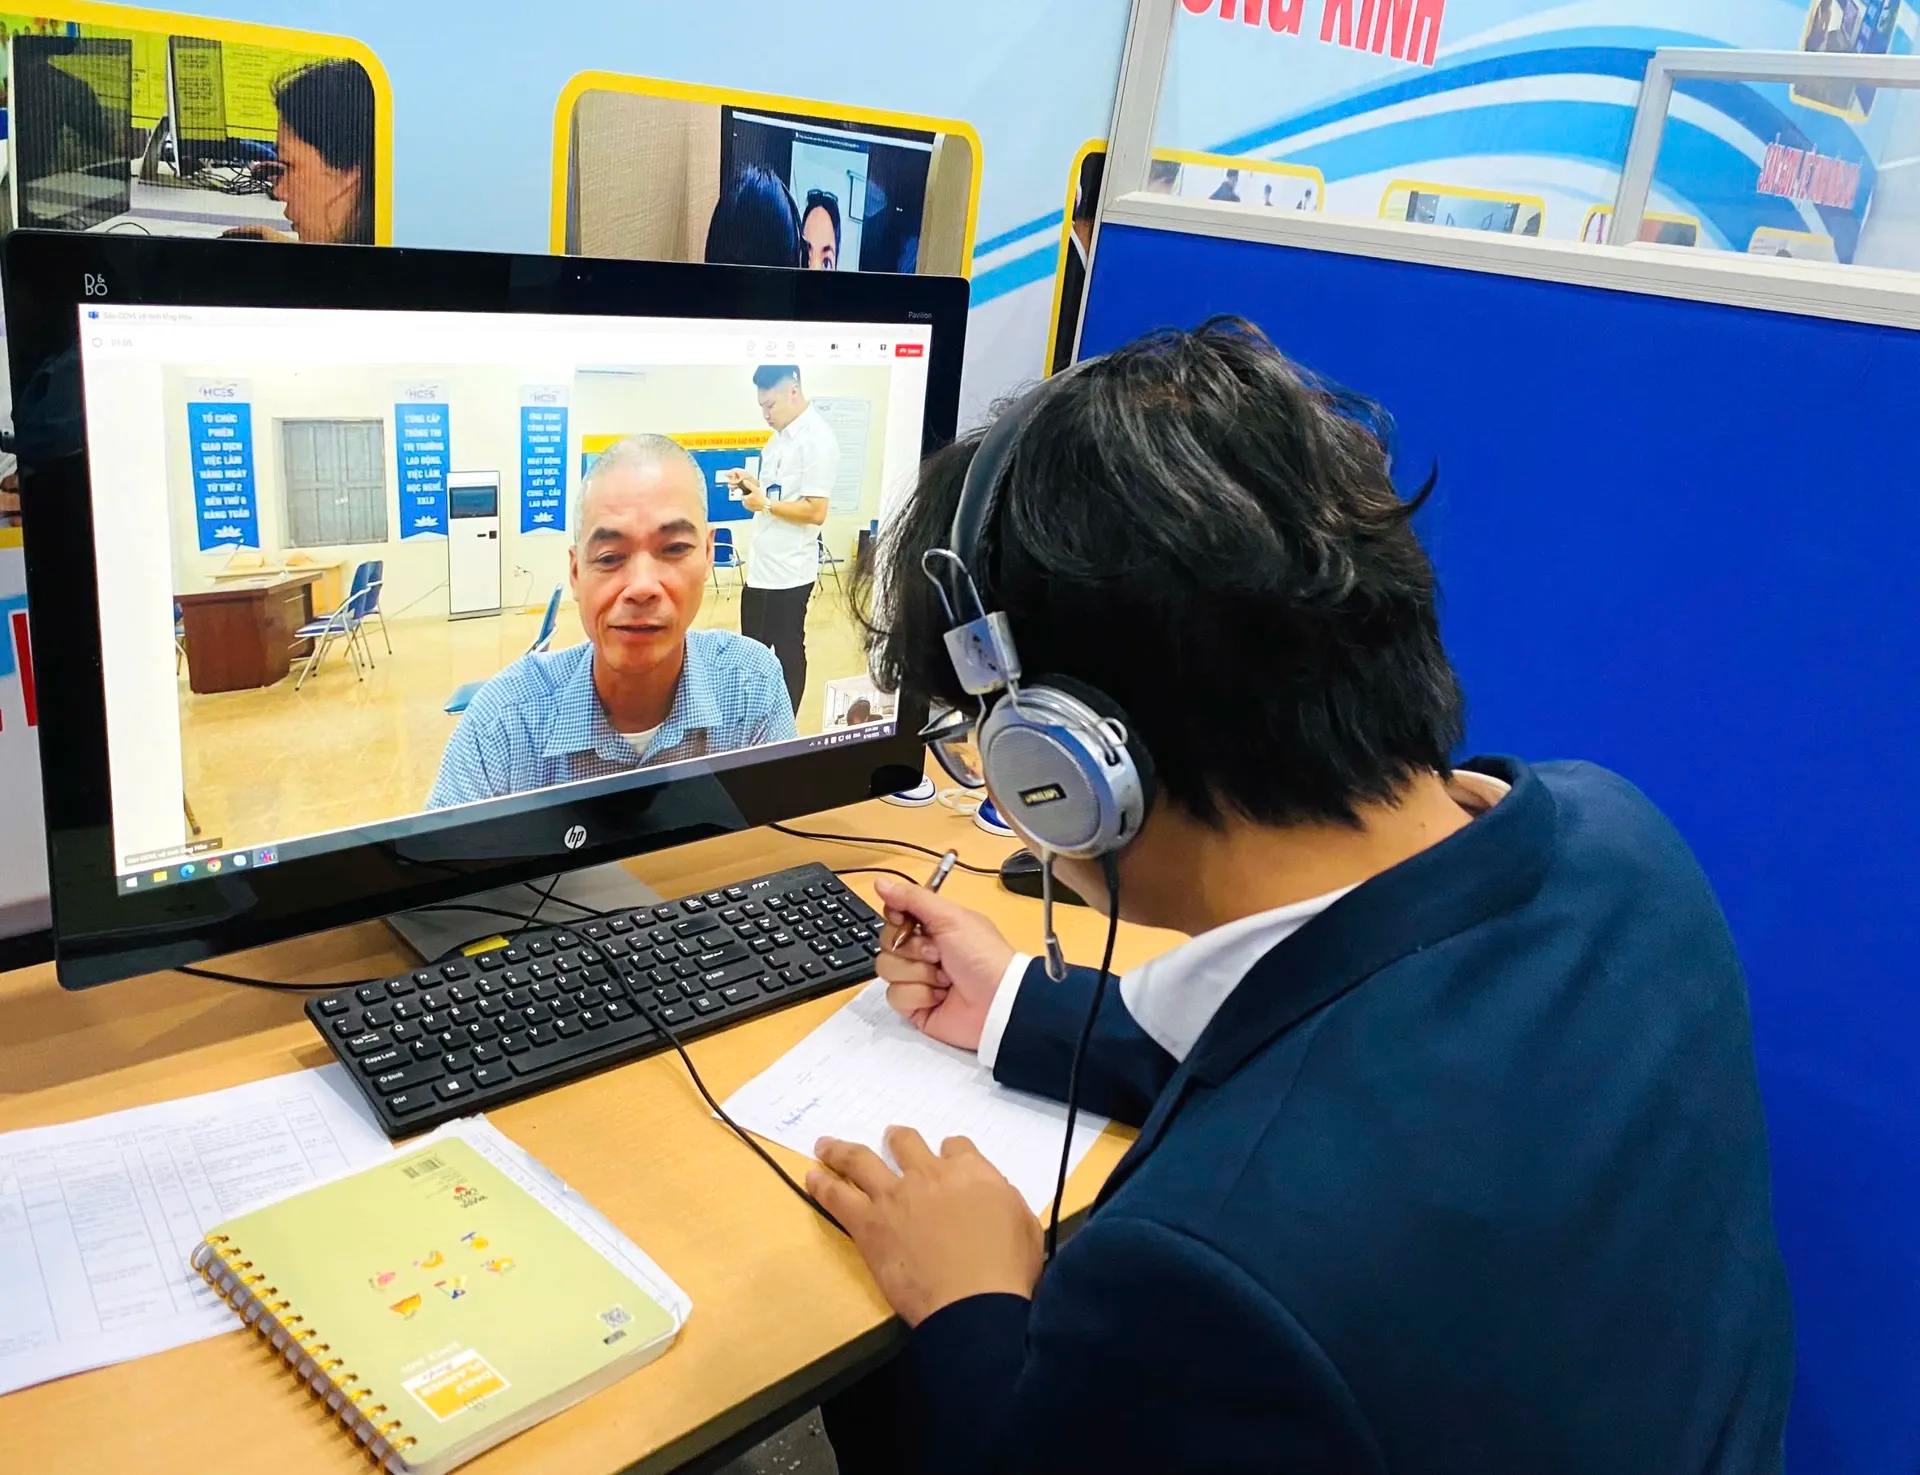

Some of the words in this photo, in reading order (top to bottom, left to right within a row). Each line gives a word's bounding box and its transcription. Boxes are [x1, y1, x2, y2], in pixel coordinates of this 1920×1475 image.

[908, 311, 932, 319] Pavilion
[565, 825, 587, 849] hp
[752, 881, 769, 890] FPT
[324, 999, 337, 1007] Esc
[551, 999, 560, 1007] H
[607, 1003, 618, 1011] M
[452, 1007, 460, 1015] E
[583, 1011, 592, 1019] N
[423, 1014, 434, 1023] W
[395, 1024, 404, 1032] Q
[529, 1027, 538, 1036] V
[443, 1032, 451, 1040] S
[502, 1036, 511, 1044] C
[416, 1041, 423, 1049] A
[475, 1045, 484, 1053] X
[364, 1056, 382, 1064] Caps
[381, 1050, 397, 1060] Lock
[446, 1054, 455, 1062] Z
[387, 1071, 404, 1080] Shift
[393, 1095, 407, 1104] Ctrl
